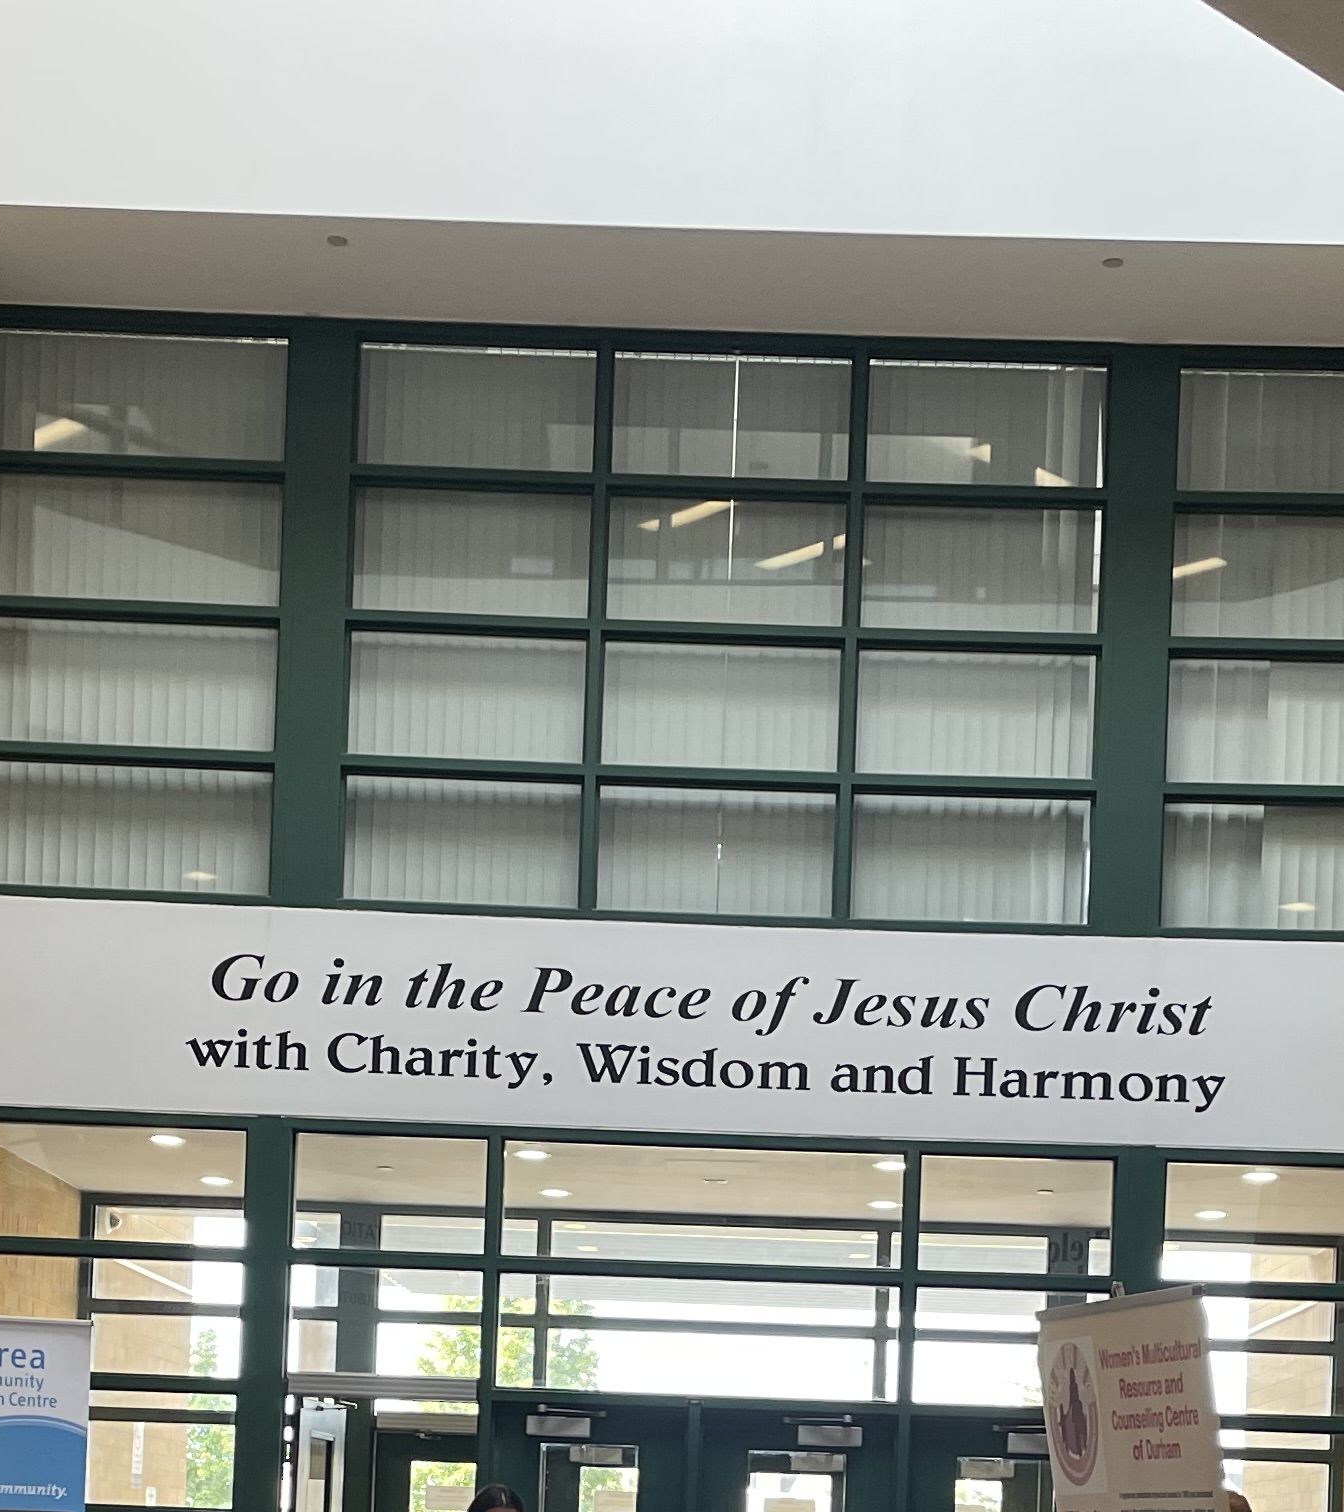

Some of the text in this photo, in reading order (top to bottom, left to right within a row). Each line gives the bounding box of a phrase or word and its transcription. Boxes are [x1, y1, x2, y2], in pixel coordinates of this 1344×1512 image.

[210, 953, 1212, 1037] Go in the Peace of Jesus Christ
[186, 1030, 1224, 1113] with Charity, Wisdom and Harmony
[1098, 1345, 1141, 1370] Women's
[1118, 1372, 1184, 1400] Resource and
[9, 1391, 58, 1408] Centre
[1165, 1406, 1200, 1428] Centre
[1133, 1439, 1181, 1461] of Durham
